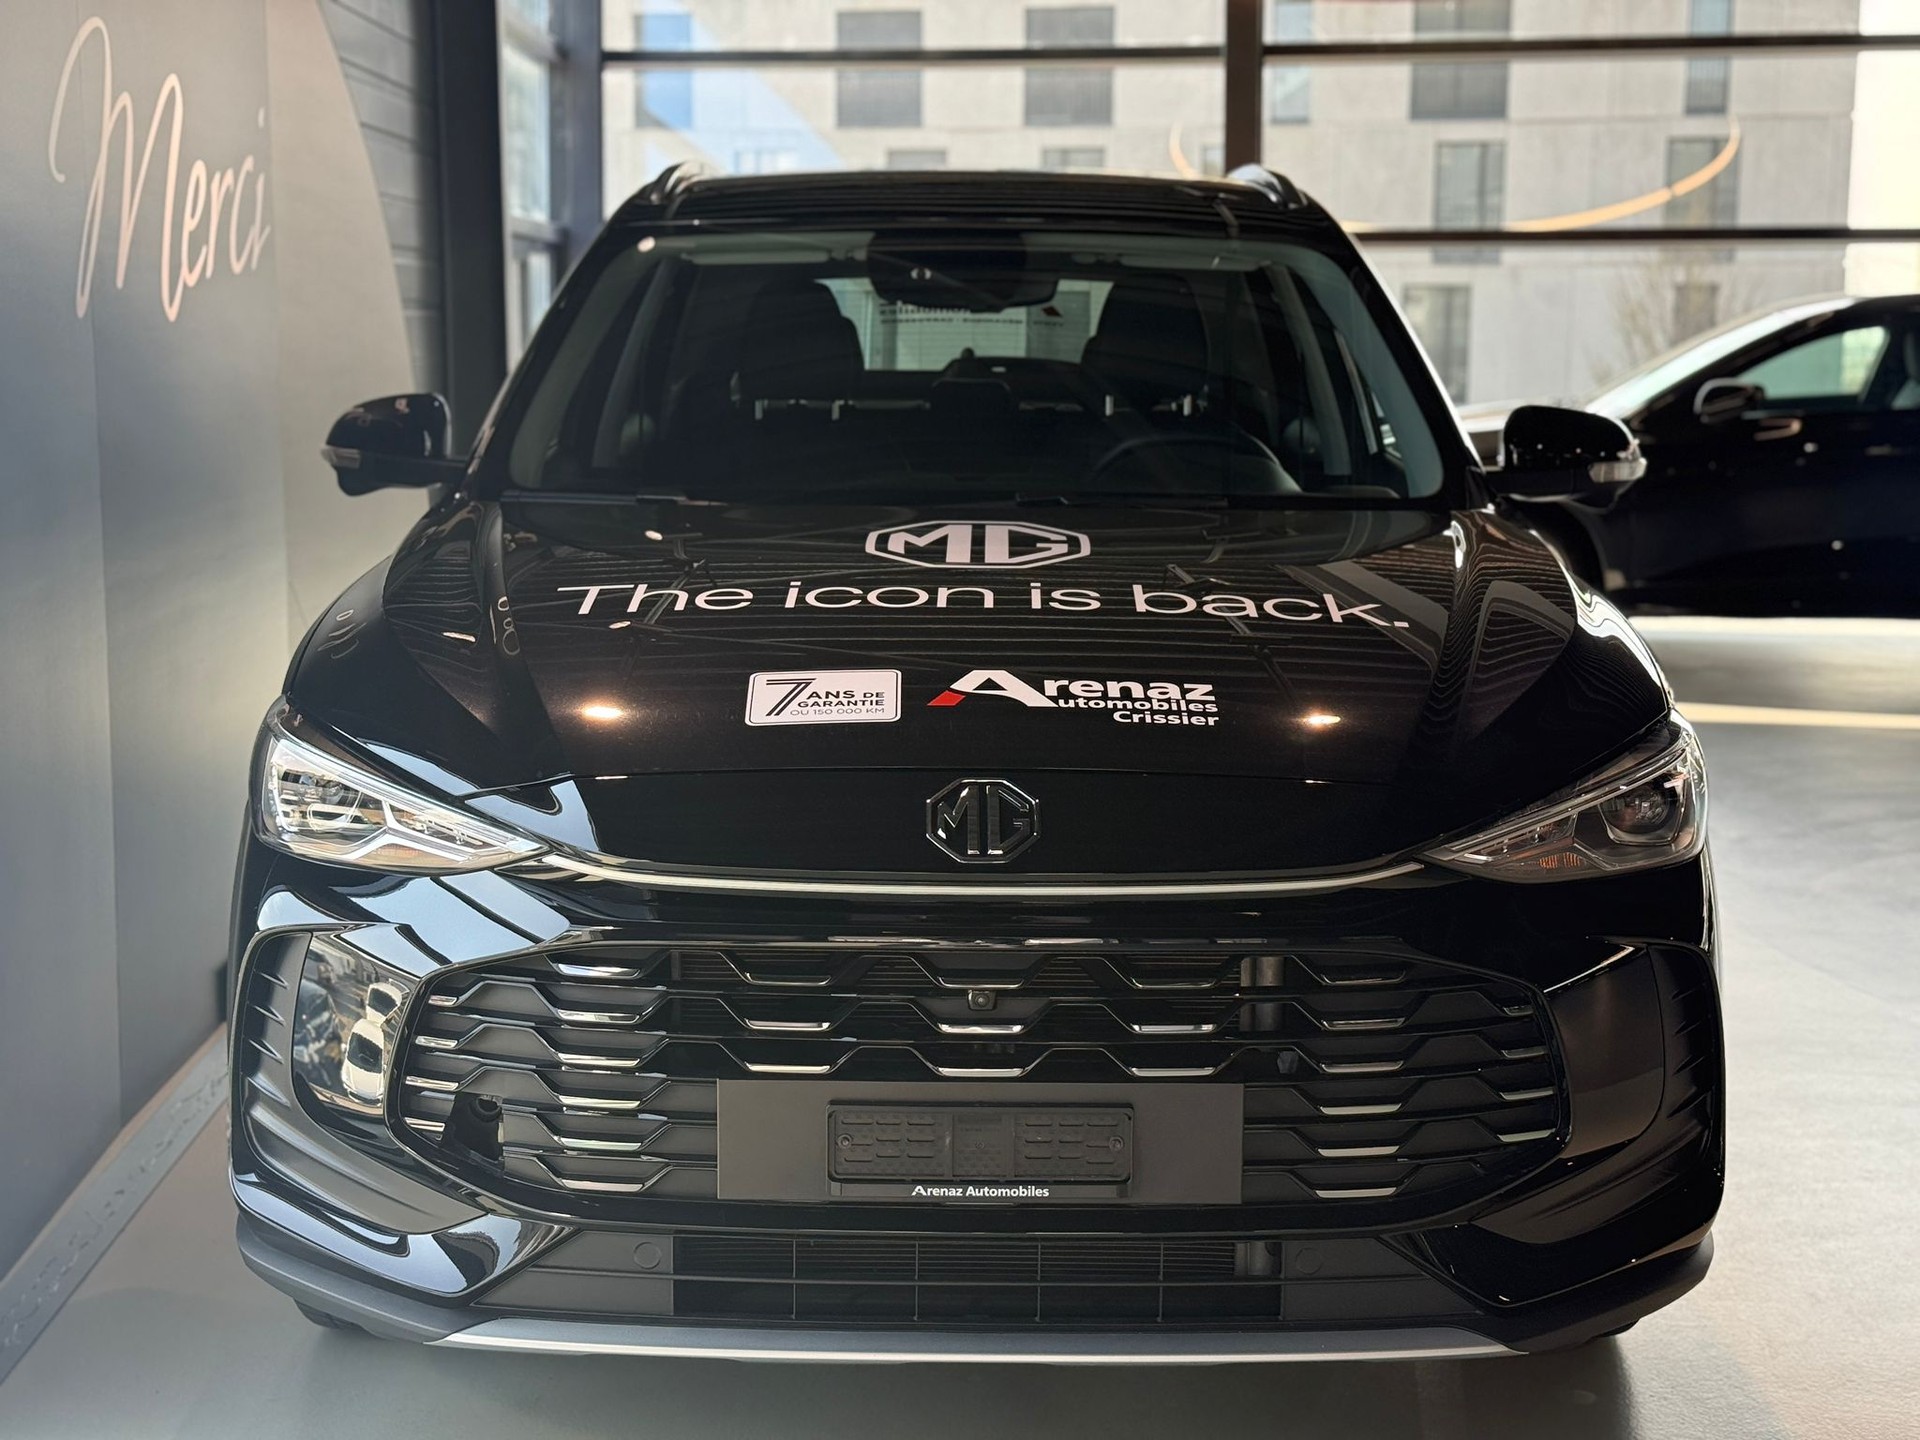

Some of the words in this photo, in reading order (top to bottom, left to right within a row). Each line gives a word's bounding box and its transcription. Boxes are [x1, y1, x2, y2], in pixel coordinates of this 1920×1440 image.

[48, 16, 271, 322] Merci
[886, 523, 1070, 564] MG
[557, 583, 754, 615] The
[784, 581, 995, 608] icon
[1030, 582, 1101, 610] is
[1132, 583, 1410, 628] back.
[765, 677, 817, 717] 7
[806, 690, 856, 700] ANS
[862, 691, 885, 699] DE
[797, 699, 885, 708] GARANTIE
[927, 669, 1216, 708] Arenaz
[1112, 711, 1220, 727] Crissier
[937, 785, 1031, 855] MG
[911, 1185, 963, 1197] Arenaz
[965, 1185, 1050, 1197] Automobiles
